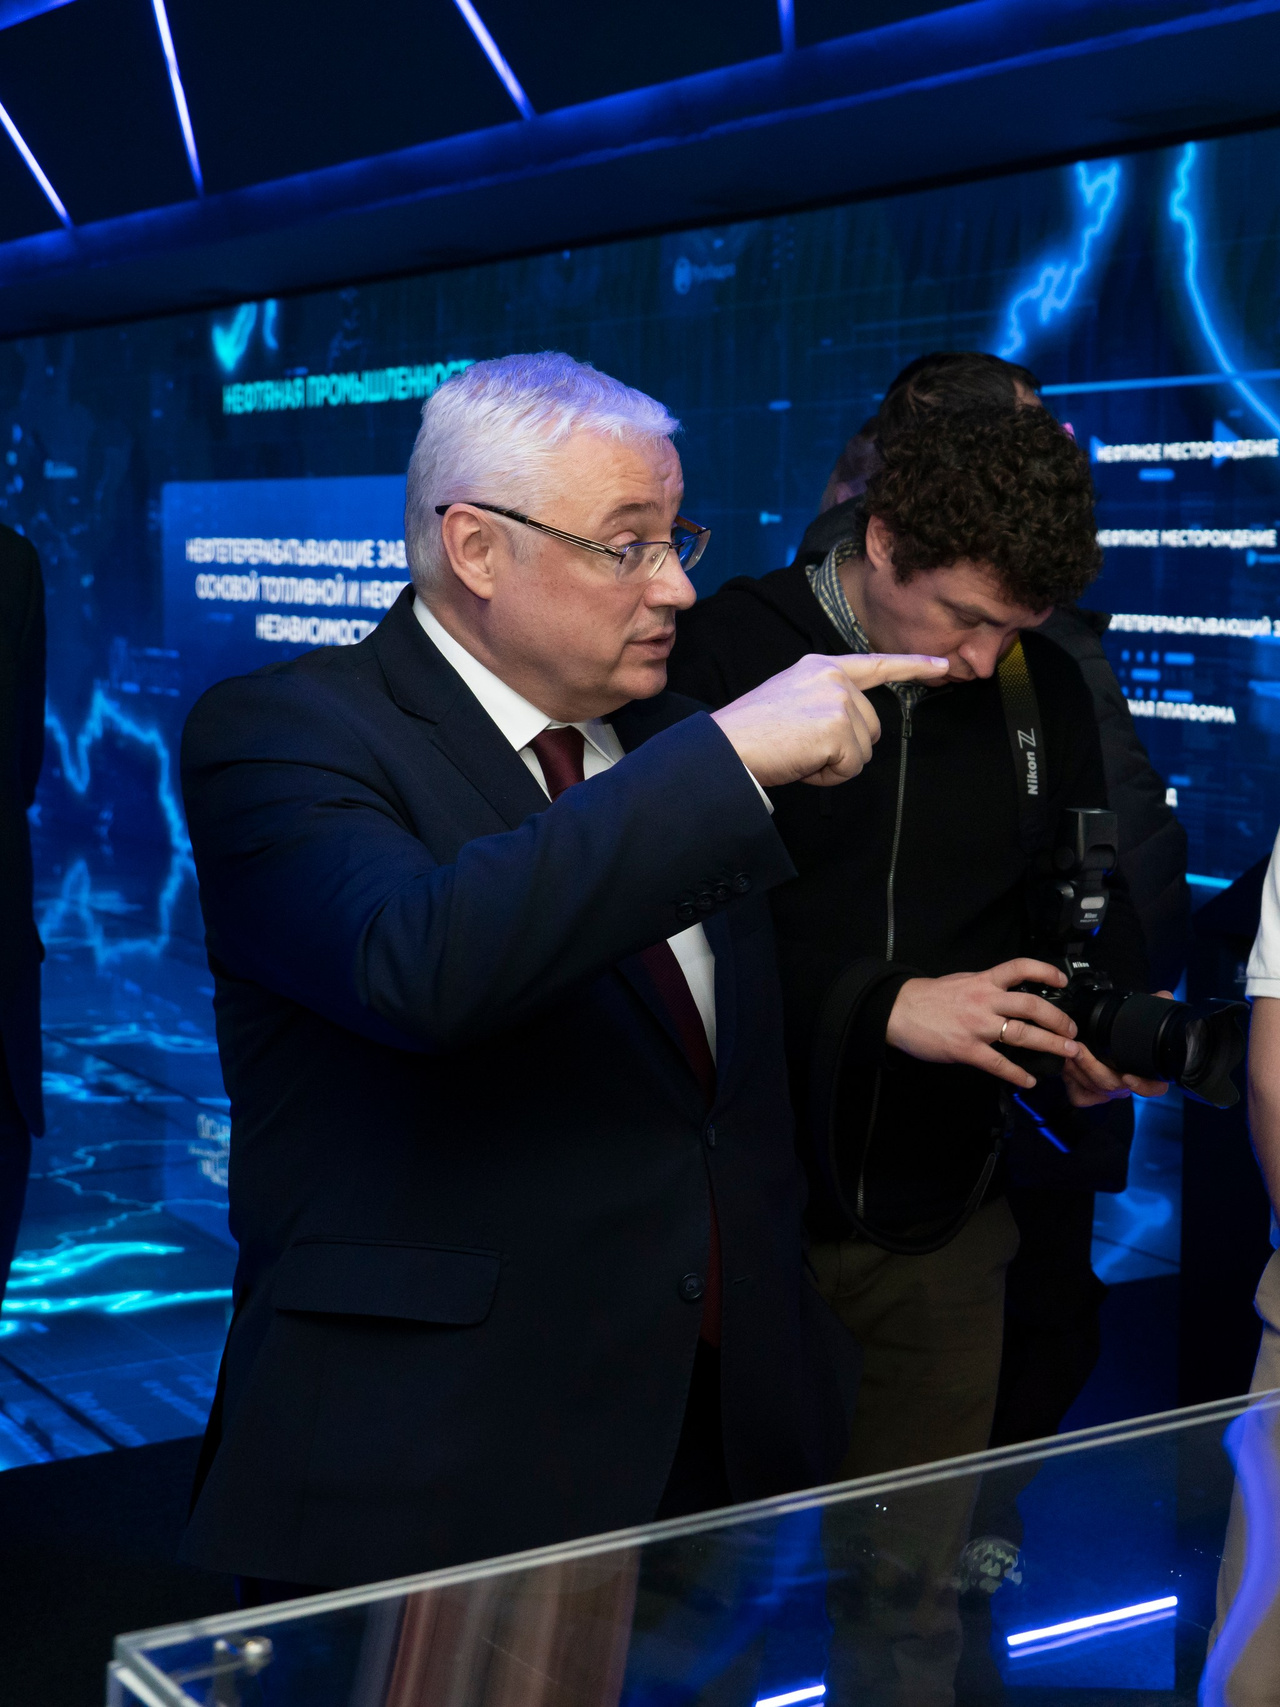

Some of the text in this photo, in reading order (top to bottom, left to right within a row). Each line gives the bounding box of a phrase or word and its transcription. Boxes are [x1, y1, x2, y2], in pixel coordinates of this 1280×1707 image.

[222, 359, 476, 415] НЕФТЯНАЯ ПРОМЫШЛЕННО
[1097, 438, 1279, 463] НЕФТЯНОЕ МЕСТОРОЖДЕНИЕ
[1161, 529, 1277, 549] МЕСТОРОЖДЕНИЕ
[185, 537, 408, 571] НЕФТЕПЕРЕРАБАТЫВАЮЩИЕ ЗАВ
[195, 569, 412, 609] ОСНОВОЙ ТОПЛИВНОЙ И НЕФТ
[1108, 613, 1271, 637] ФТЕПЕРЕРАБАТЫВАЮЩИЙ
[1156, 700, 1236, 724] ПЛАТФОРМА
[1017, 727, 1039, 795] Nikon Z
[1072, 961, 1090, 969] Nikon
